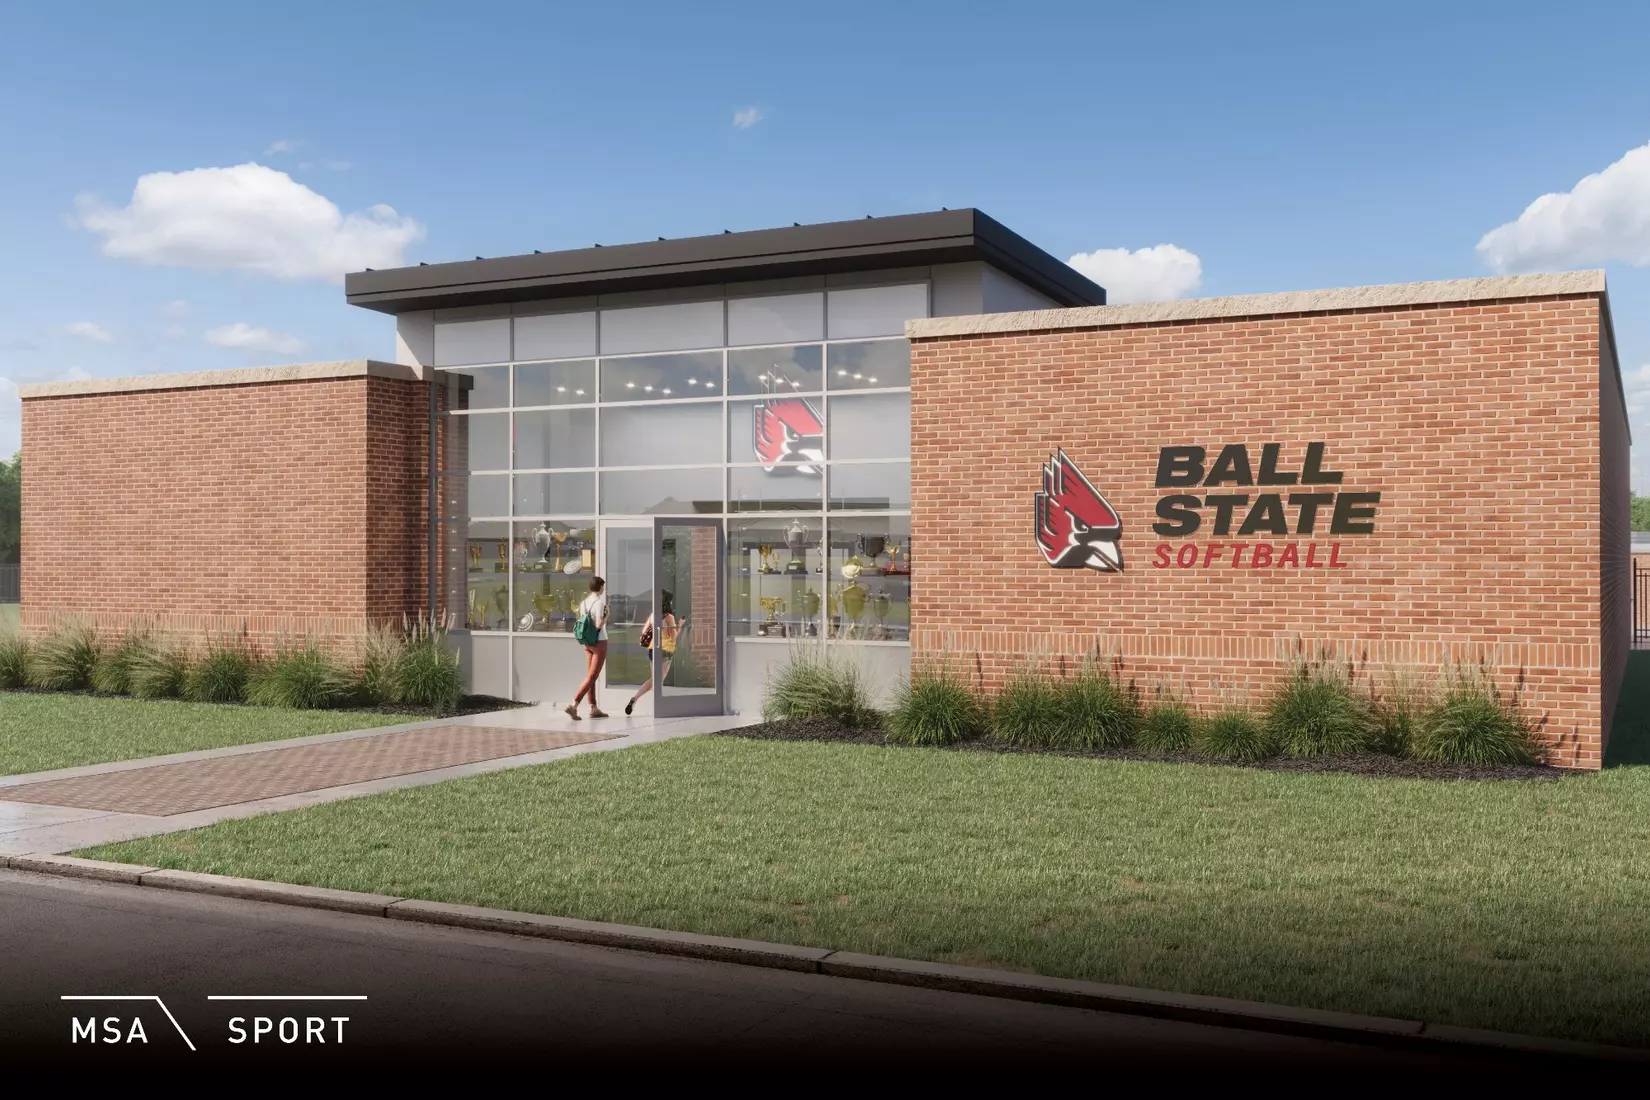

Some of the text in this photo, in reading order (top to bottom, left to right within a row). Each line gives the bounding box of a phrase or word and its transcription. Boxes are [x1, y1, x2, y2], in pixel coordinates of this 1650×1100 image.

[1154, 442, 1344, 488] BALL
[1152, 491, 1381, 537] STATE
[1152, 543, 1348, 569] SOFTBALL
